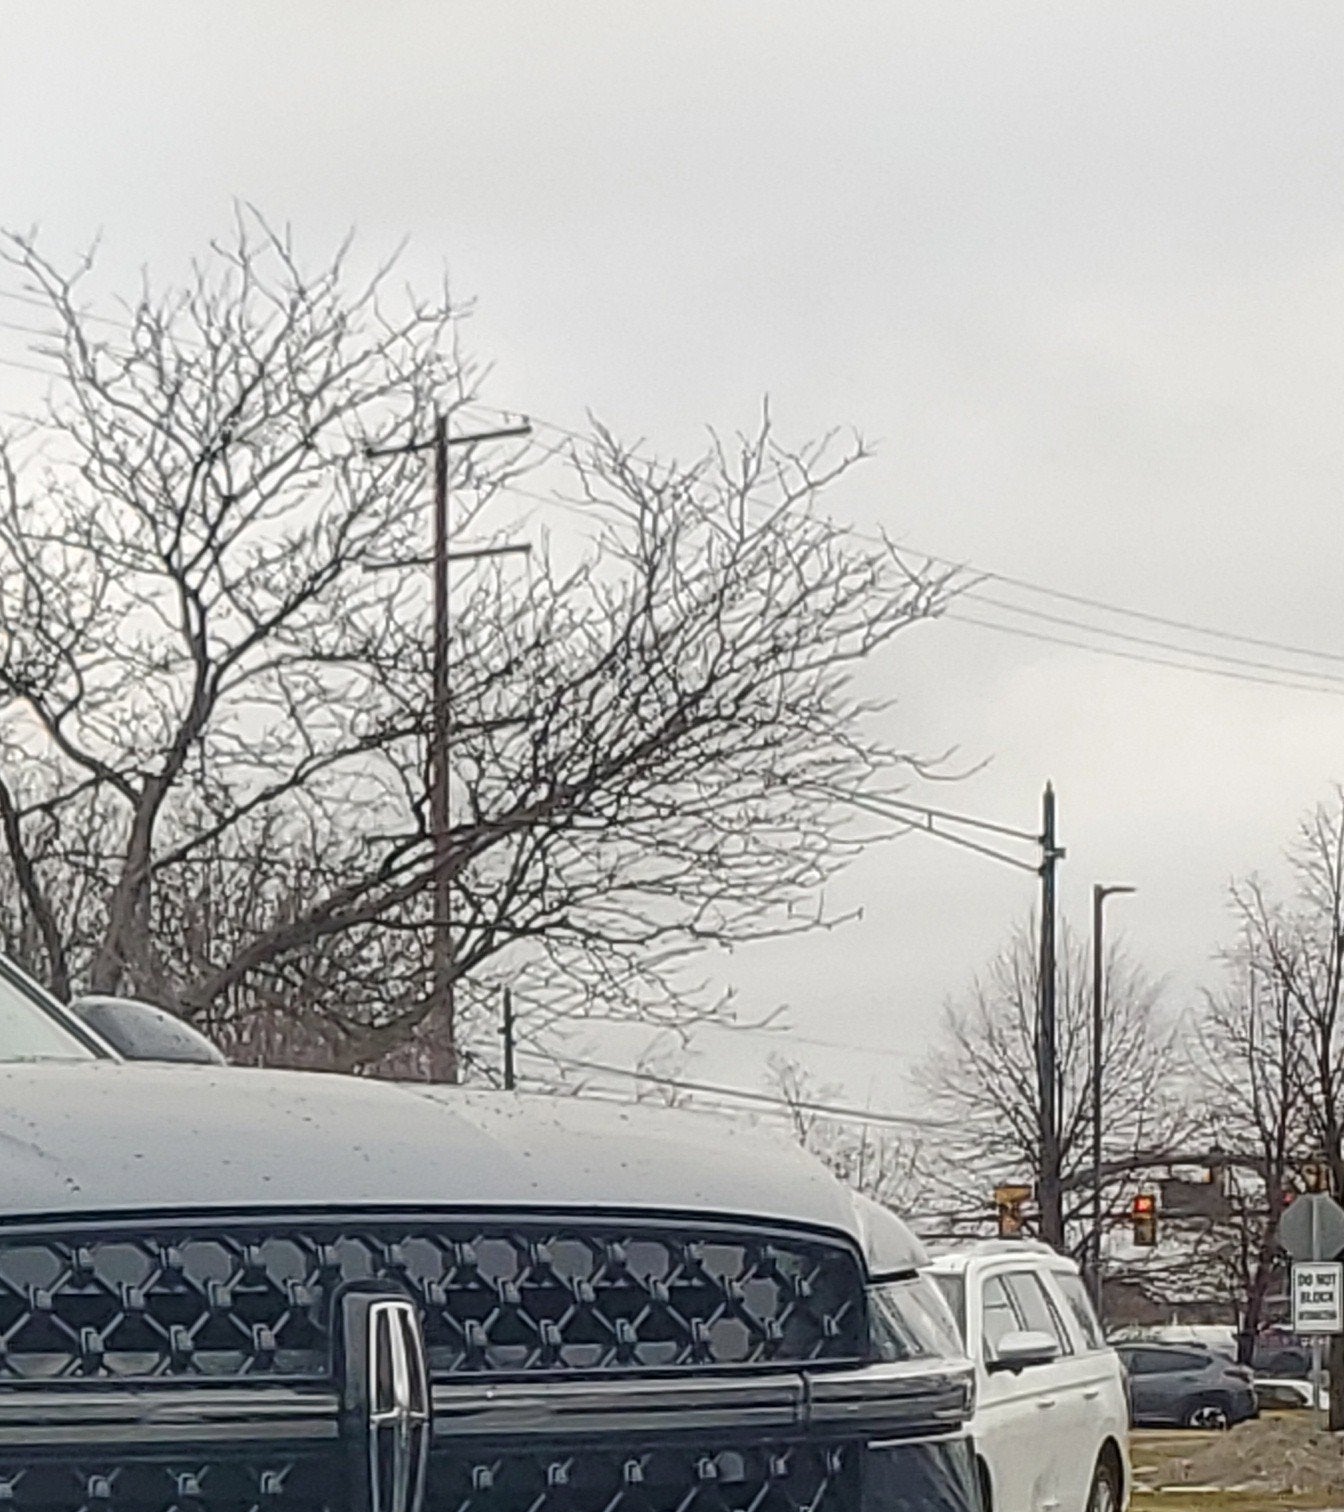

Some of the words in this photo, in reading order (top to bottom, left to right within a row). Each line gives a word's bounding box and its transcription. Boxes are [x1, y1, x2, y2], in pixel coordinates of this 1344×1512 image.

[1298, 1273, 1313, 1287] DO
[1317, 1273, 1336, 1286] NOT
[1301, 1291, 1333, 1304] BLOCK
